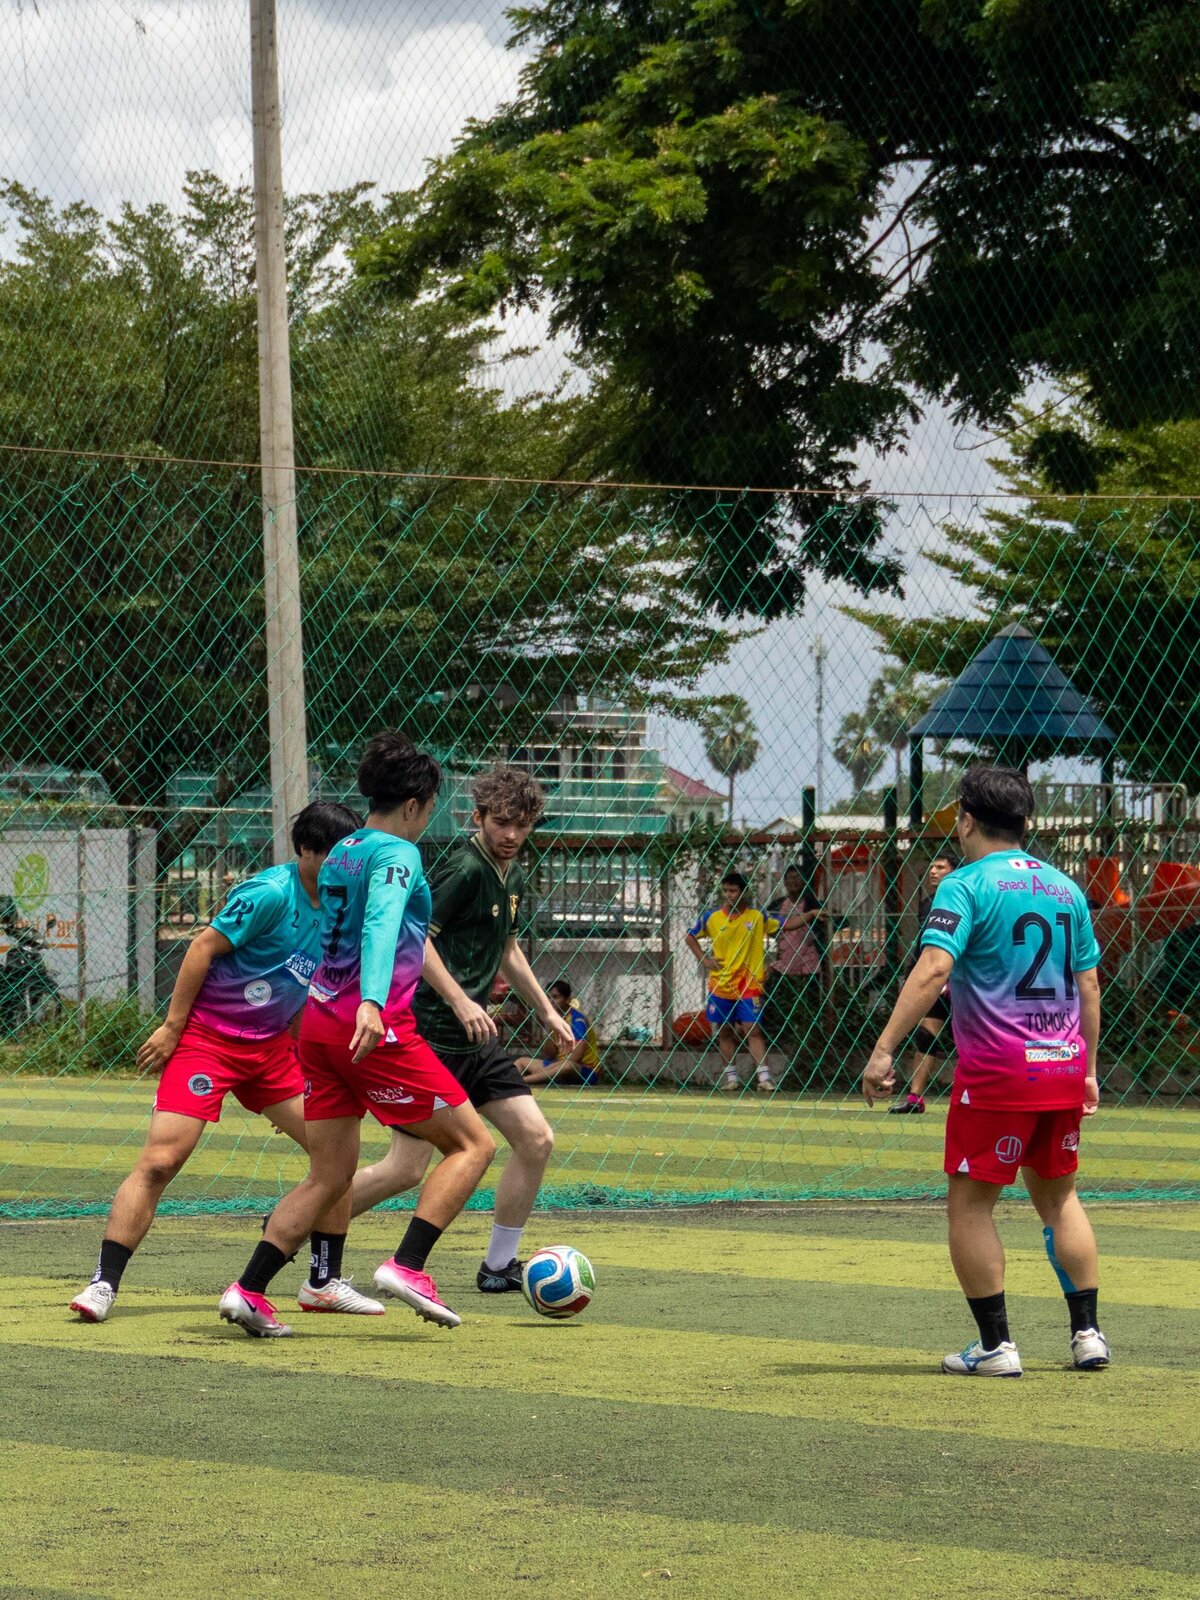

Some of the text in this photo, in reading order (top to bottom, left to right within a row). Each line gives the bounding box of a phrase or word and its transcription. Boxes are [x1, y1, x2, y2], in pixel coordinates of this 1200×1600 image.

[385, 865, 410, 889] R
[997, 880, 1028, 892] Snack
[1012, 911, 1074, 1001] 21
